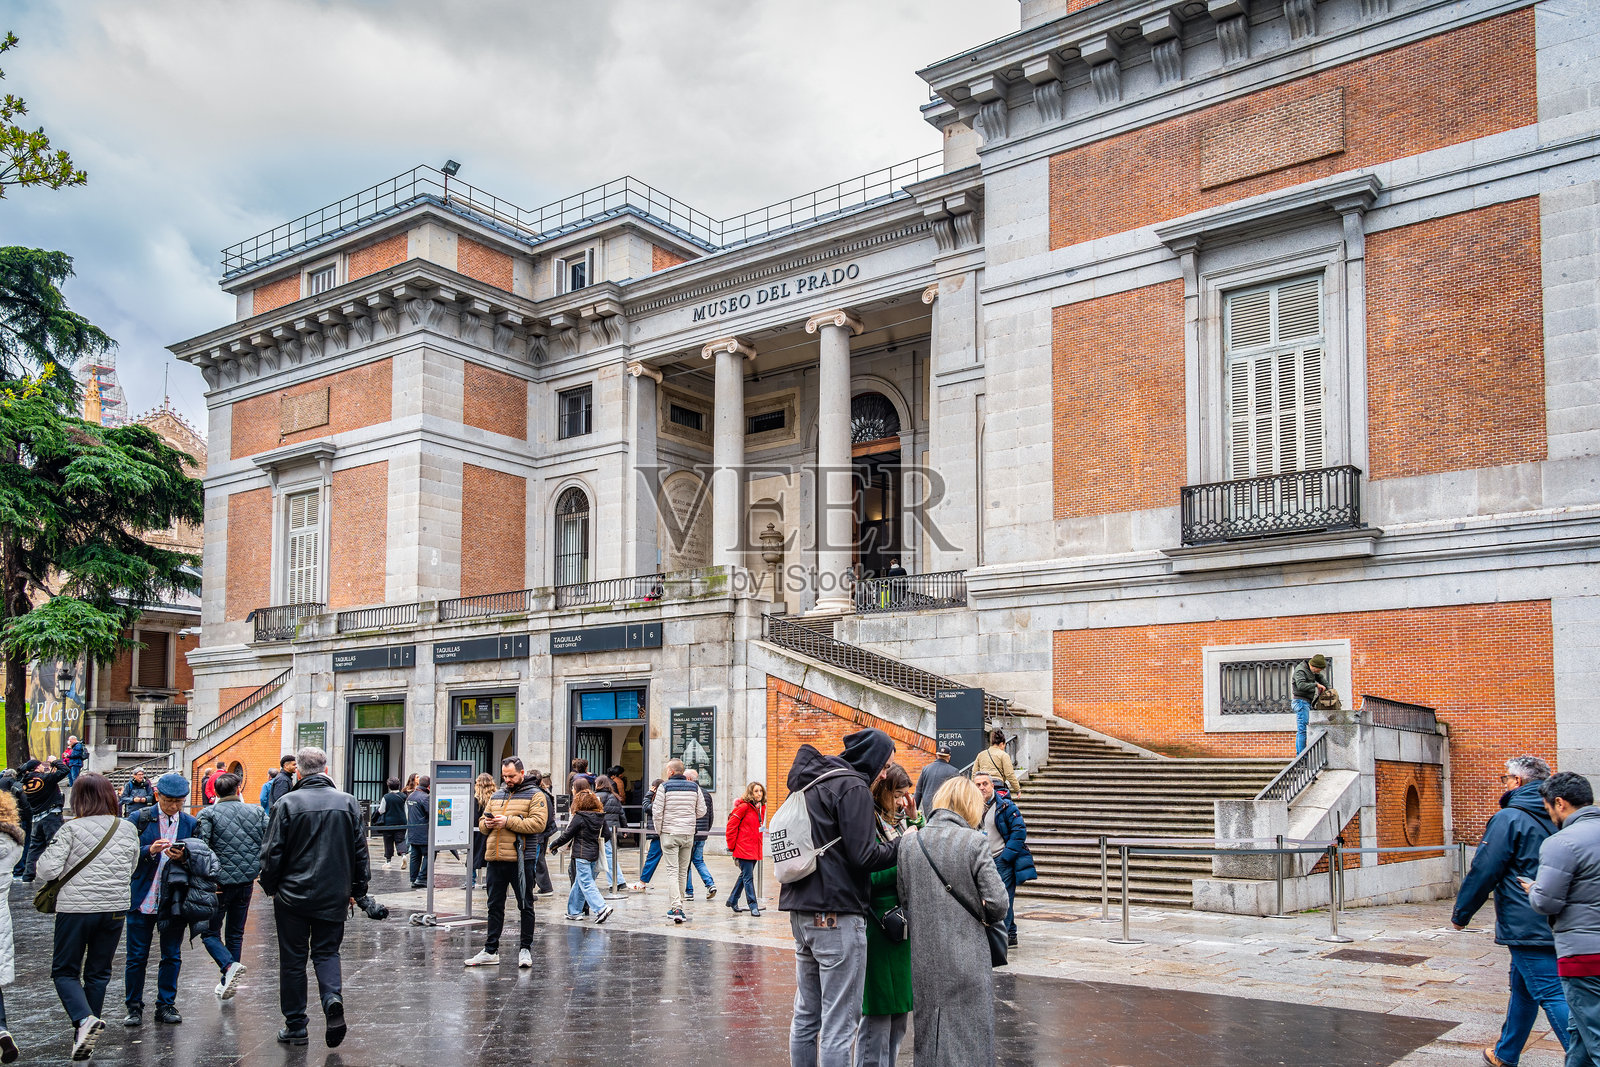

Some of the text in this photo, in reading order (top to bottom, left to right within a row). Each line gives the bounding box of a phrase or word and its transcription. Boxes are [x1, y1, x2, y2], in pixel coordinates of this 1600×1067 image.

[692, 263, 860, 323] MUSEO DEL PRADO
[553, 635, 582, 643] TAQUILLAS
[632, 632, 637, 640] 5
[649, 631, 654, 639] 6
[436, 646, 461, 654] TAQUILLAS
[36, 701, 79, 722] El Grco
